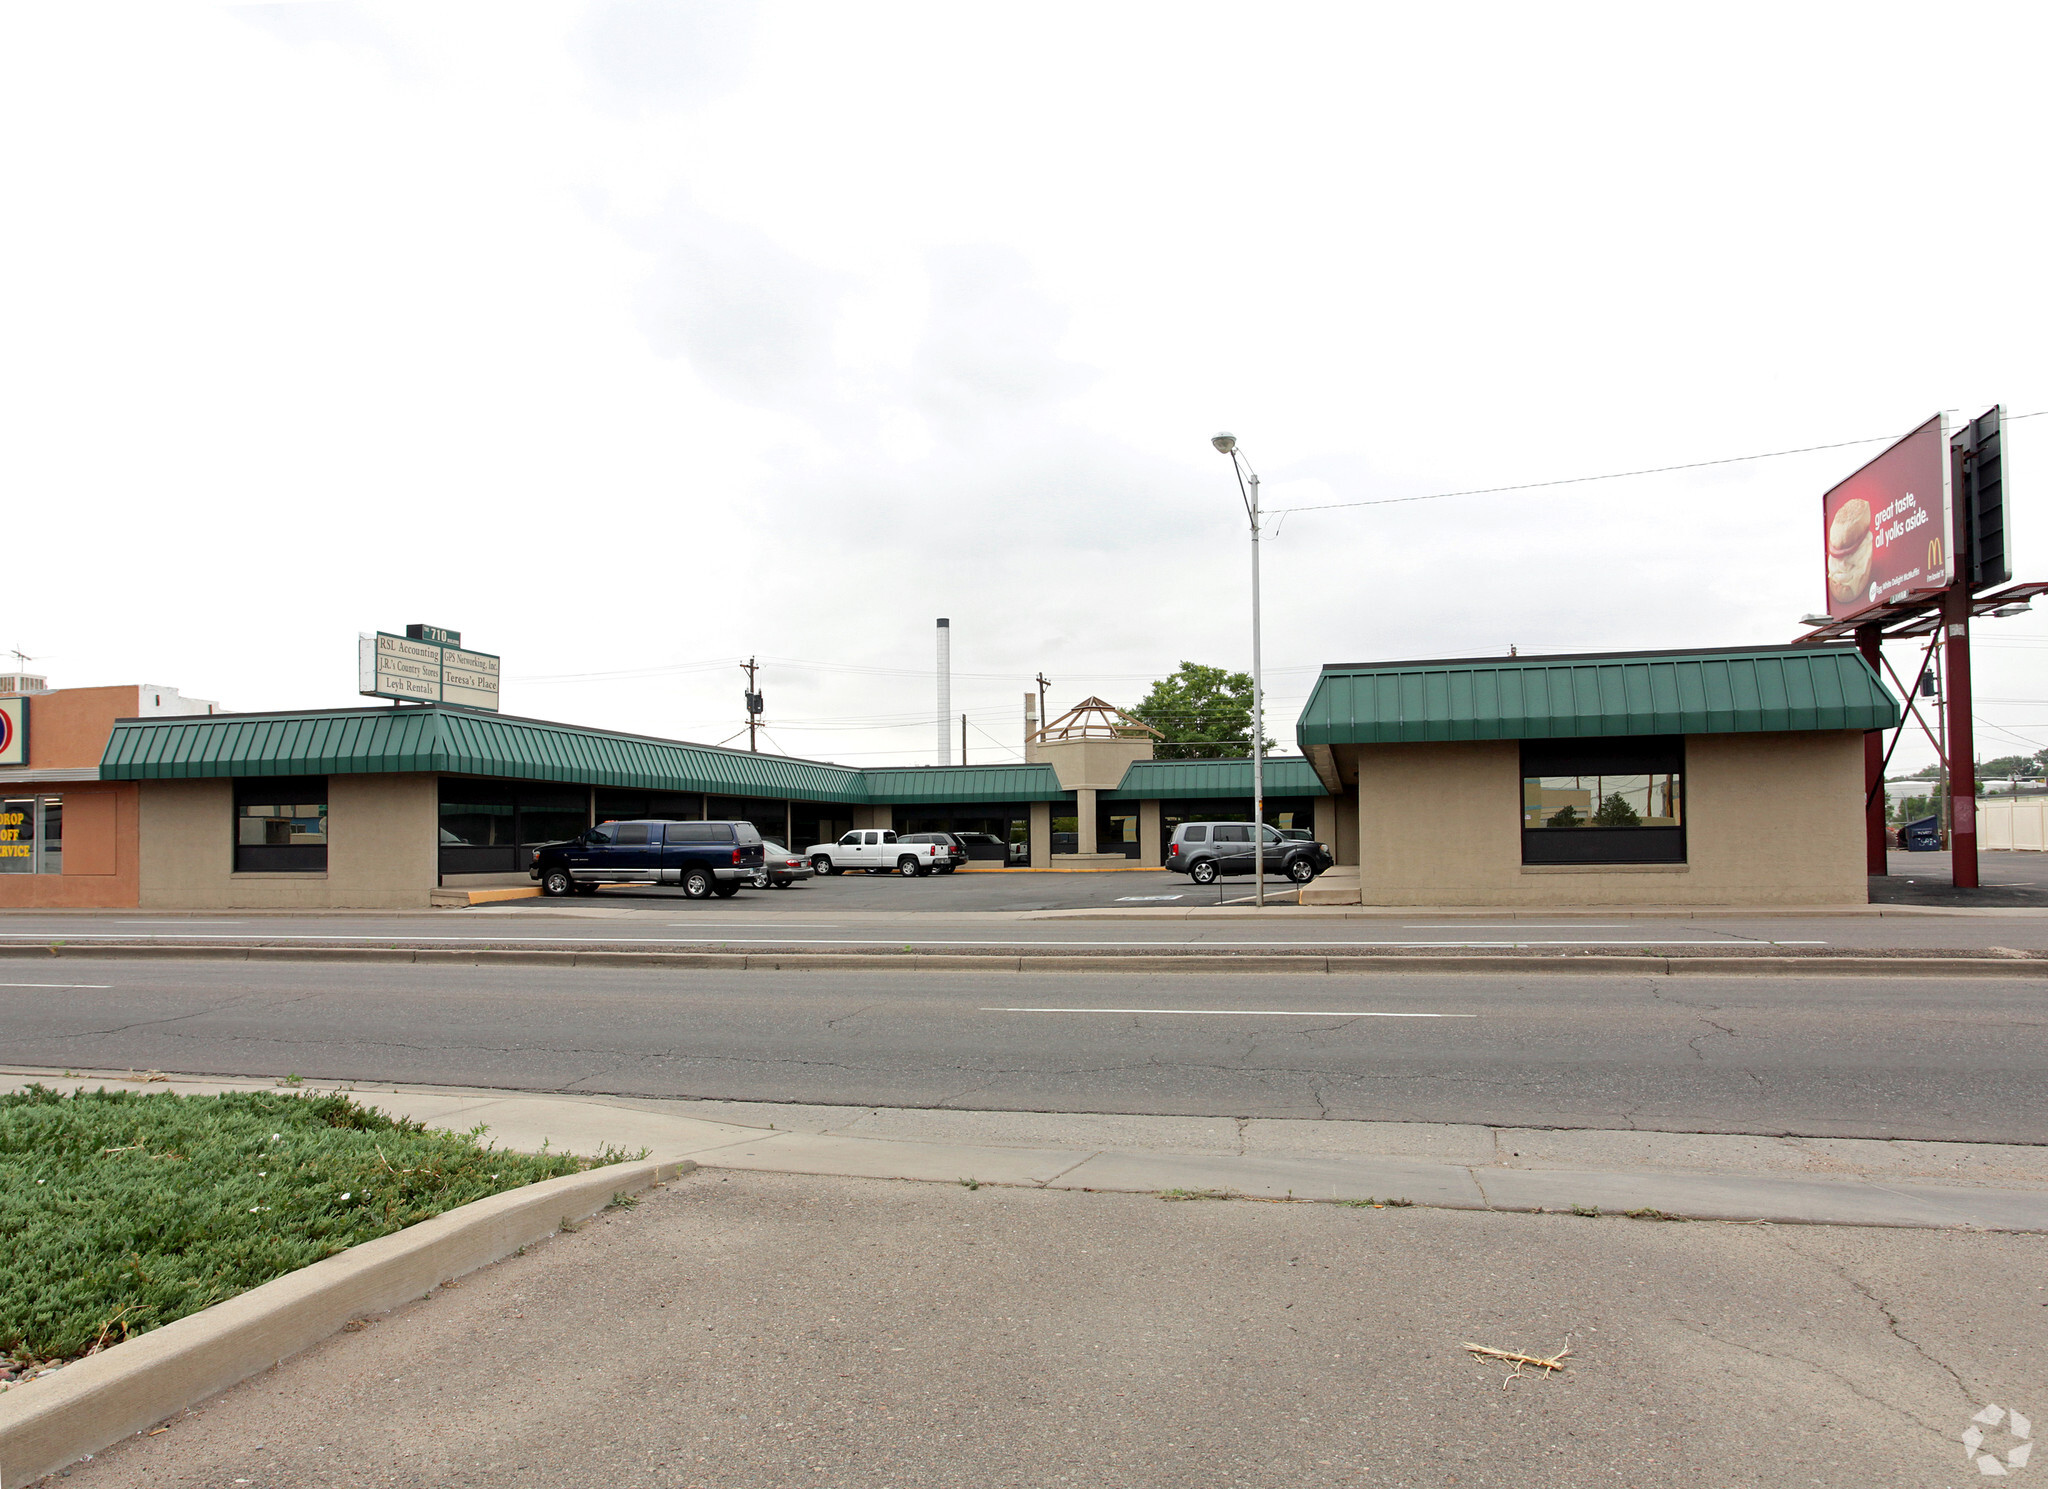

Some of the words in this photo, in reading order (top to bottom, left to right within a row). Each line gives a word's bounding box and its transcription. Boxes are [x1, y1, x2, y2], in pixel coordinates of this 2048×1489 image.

[1874, 502, 1893, 531] great
[1895, 492, 1916, 515] taste,
[1875, 528, 1884, 548] all
[1885, 520, 1904, 548] yolks
[1905, 507, 1929, 532] aside.
[431, 628, 447, 642] 710
[380, 637, 396, 651] RSL
[398, 642, 439, 662] Accounting
[379, 657, 396, 671] J.R.'s
[397, 660, 421, 677] Country
[422, 665, 439, 678] Stores
[444, 651, 456, 663] GPS
[488, 660, 498, 671] Inc.
[386, 677, 404, 692] Leyh
[406, 681, 433, 694] Rentals
[445, 671, 475, 686] Teresa's
[477, 676, 497, 690] Place
[0, 829, 19, 841] OFF
